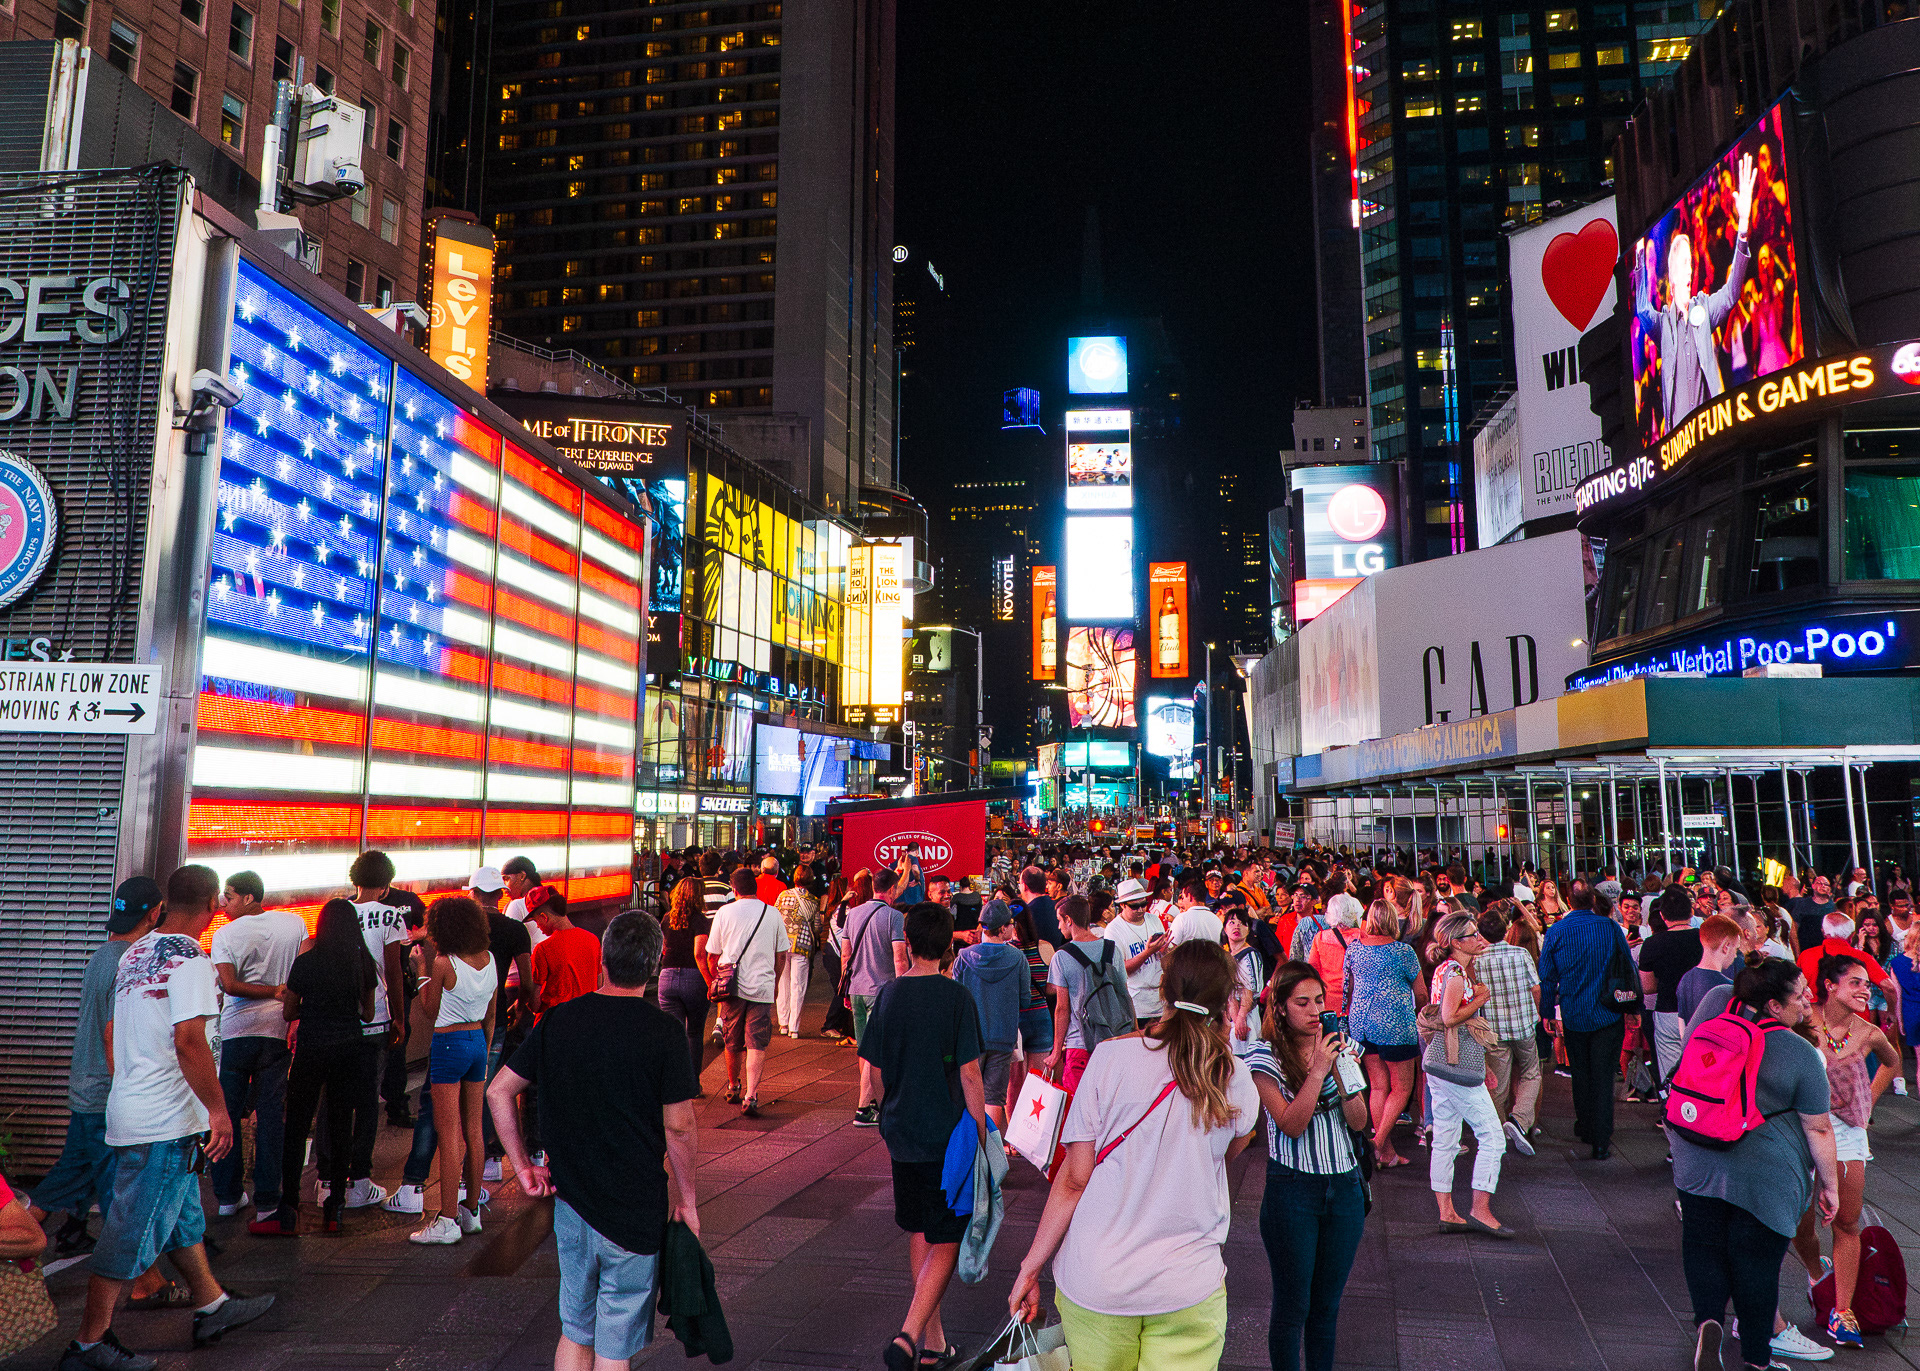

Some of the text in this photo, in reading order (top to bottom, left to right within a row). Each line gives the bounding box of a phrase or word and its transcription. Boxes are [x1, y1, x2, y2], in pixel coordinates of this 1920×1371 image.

[568, 418, 672, 446] THRONES
[1576, 468, 1627, 515] STARTING
[1661, 418, 1697, 471] SUNDAY
[1698, 400, 1733, 436] FUN
[1737, 392, 1755, 422] &
[1758, 357, 1875, 413] GAMES
[588, 449, 653, 464] EXPERIENCE
[598, 461, 634, 472] DJAWADI
[4, 469, 42, 523] THE NAVY
[1537, 497, 1551, 506] THE
[17, 537, 39, 572] CORPS
[1333, 544, 1385, 576] LG
[877, 576, 897, 588] LION
[880, 567, 894, 575] THE
[875, 589, 900, 604] KING
[1002, 554, 1014, 621] NOVOTEL
[776, 569, 835, 635] LION KING
[1672, 641, 1733, 674] 'Verbal
[1739, 621, 1896, 668] Poo-Poo'
[0, 671, 150, 693] STRIAN FLOW ZONE
[0, 700, 59, 720] MOVING
[1364, 717, 1502, 773] GOOD MORNING AMERICA
[1129, 941, 1145, 958] NEW
